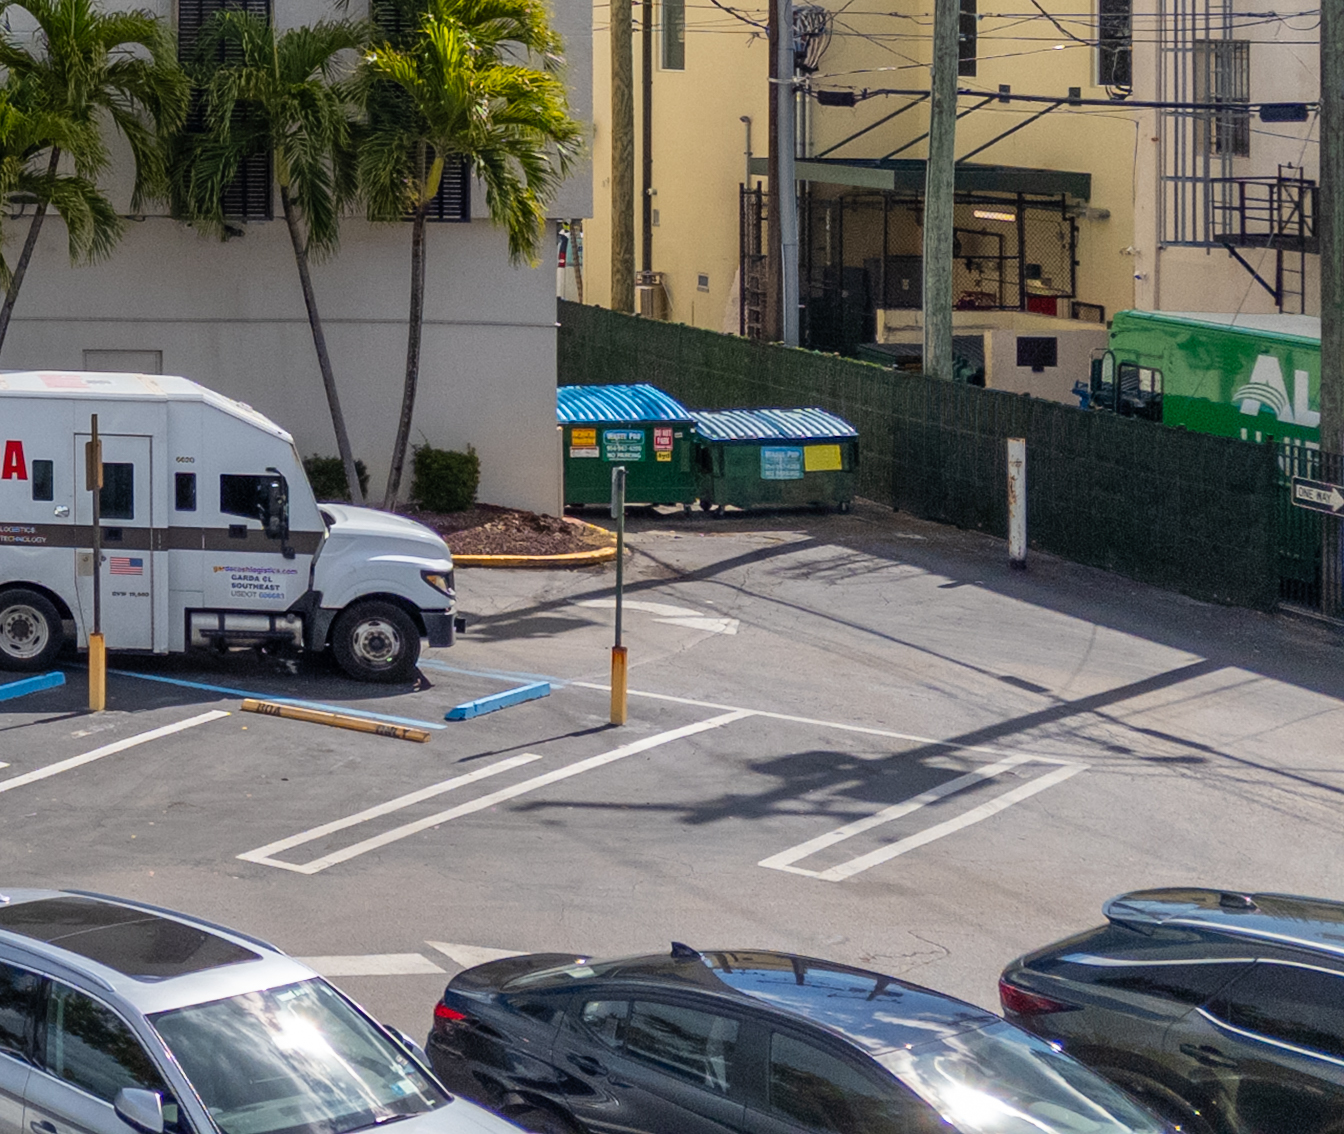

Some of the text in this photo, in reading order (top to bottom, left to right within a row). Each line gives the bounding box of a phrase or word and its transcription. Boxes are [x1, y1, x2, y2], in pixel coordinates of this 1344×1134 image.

[1298, 486, 1332, 504] ONE WAY
[213, 566, 298, 575] gardacashlogistics.com
[231, 574, 260, 582] GARDA
[231, 582, 280, 591] SOUTHEAST
[231, 590, 257, 598] USDOT
